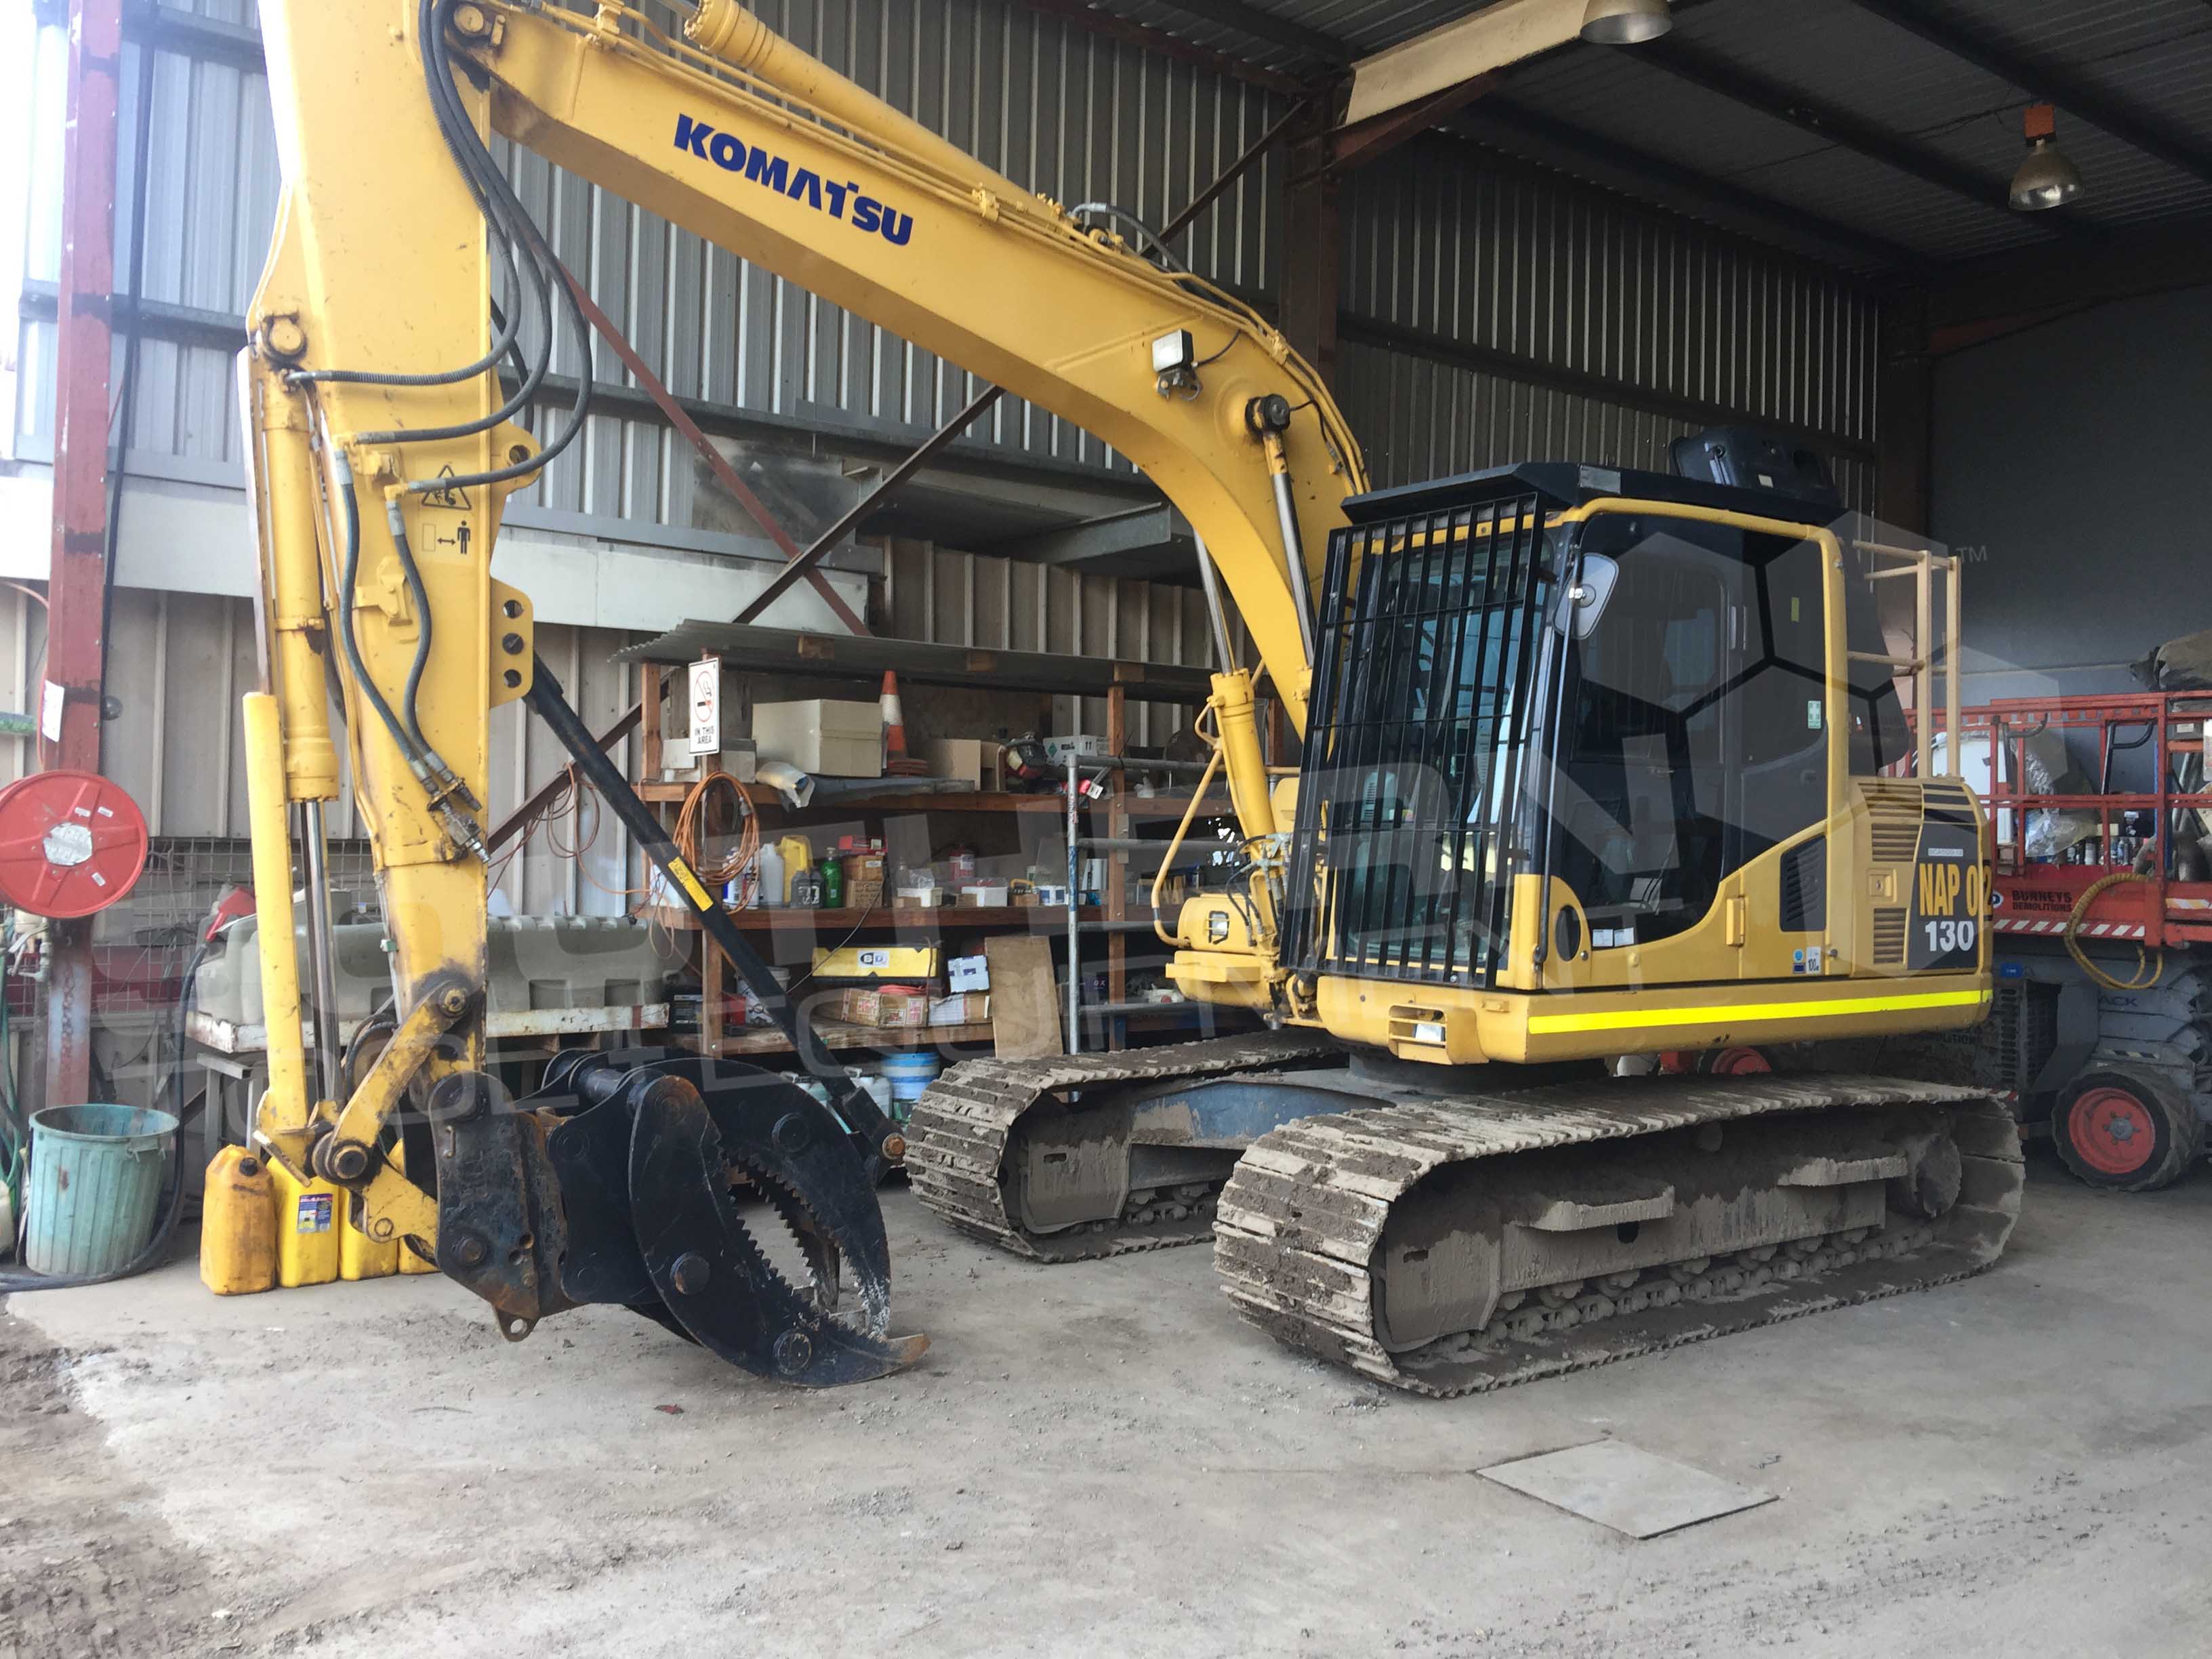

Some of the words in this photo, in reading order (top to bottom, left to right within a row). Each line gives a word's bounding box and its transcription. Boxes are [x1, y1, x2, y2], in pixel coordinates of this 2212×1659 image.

[674, 113, 914, 246] KOMATSU
[695, 727, 701, 736] IN
[702, 725, 714, 735] THIS
[698, 735, 712, 744] AREA
[1919, 863, 1960, 916] NAP
[1925, 920, 1974, 952] 130
